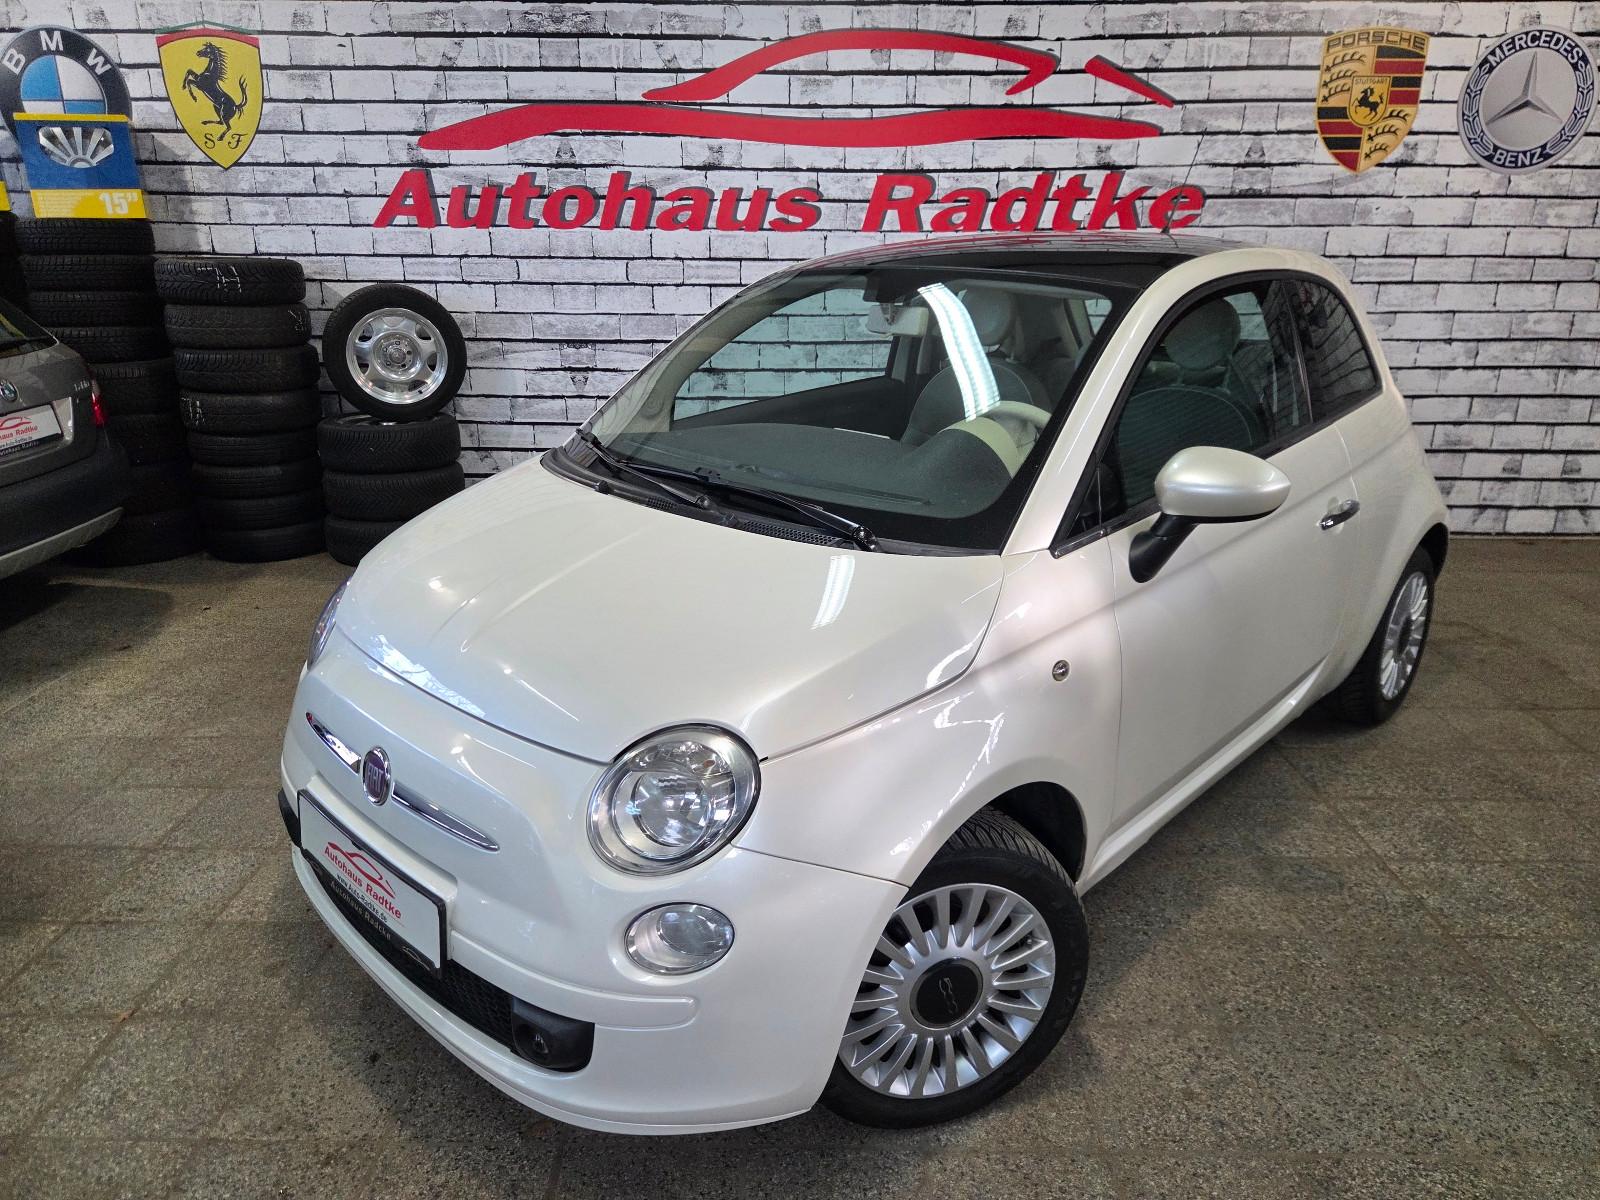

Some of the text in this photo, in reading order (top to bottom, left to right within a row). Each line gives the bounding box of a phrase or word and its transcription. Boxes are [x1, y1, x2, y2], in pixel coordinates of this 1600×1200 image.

[3, 30, 113, 76] BMW
[1326, 30, 1426, 52] PORSCHE
[1488, 30, 1582, 67] MERCEDES
[1493, 150, 1544, 167] BENZ
[372, 169, 1206, 232] Autohaus Radtke
[367, 762, 384, 792] FIAT
[325, 846, 402, 919] Autohaus Radtke
